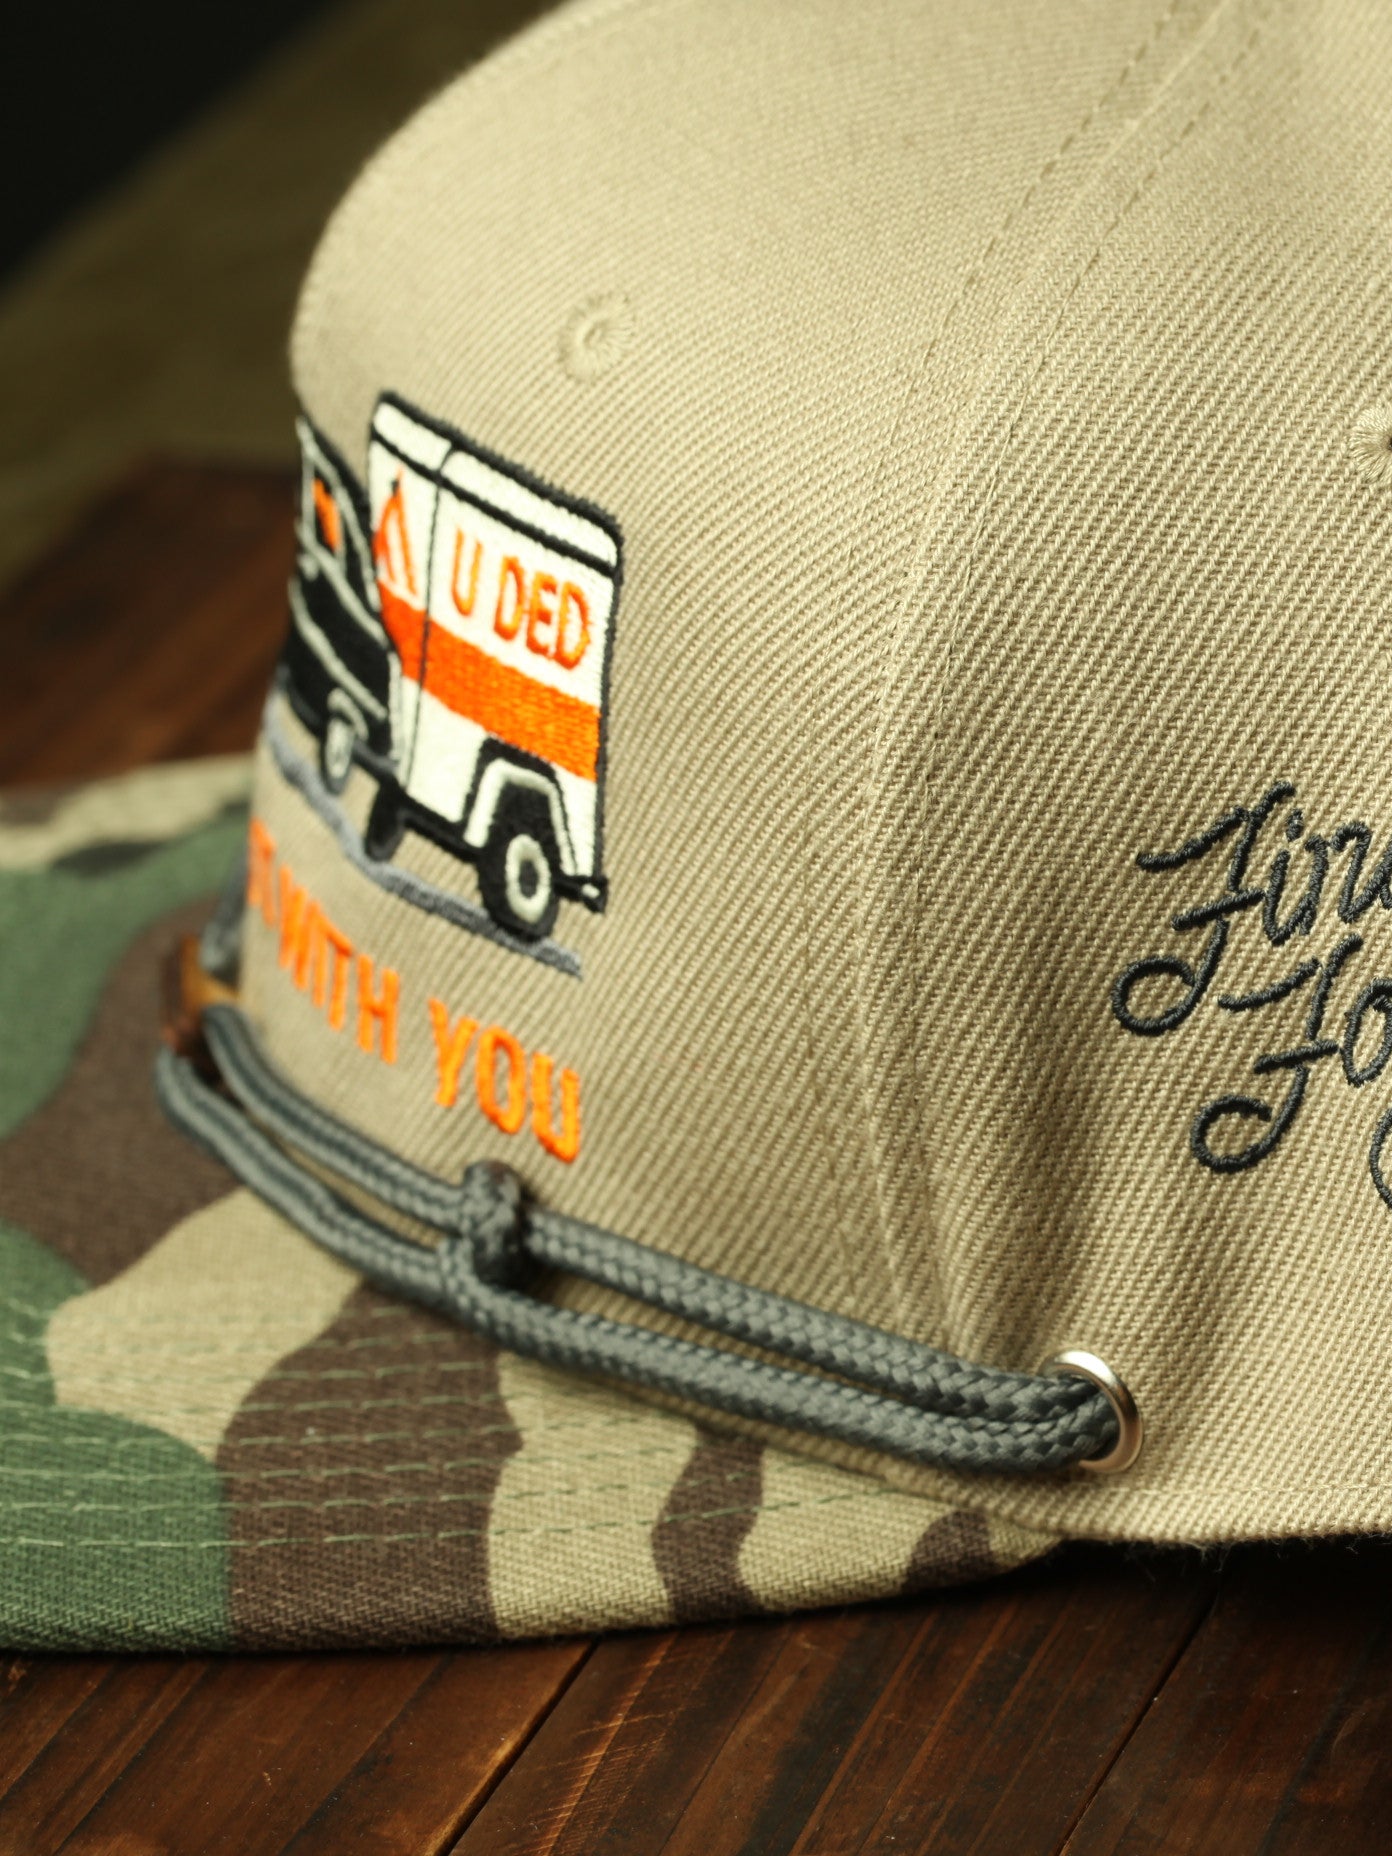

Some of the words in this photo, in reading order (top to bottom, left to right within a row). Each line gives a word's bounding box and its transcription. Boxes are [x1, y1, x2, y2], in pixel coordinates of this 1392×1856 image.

[451, 525, 484, 618] U
[493, 555, 593, 671] DED
[279, 864, 400, 1065] WITH
[430, 997, 581, 1163] YOU
